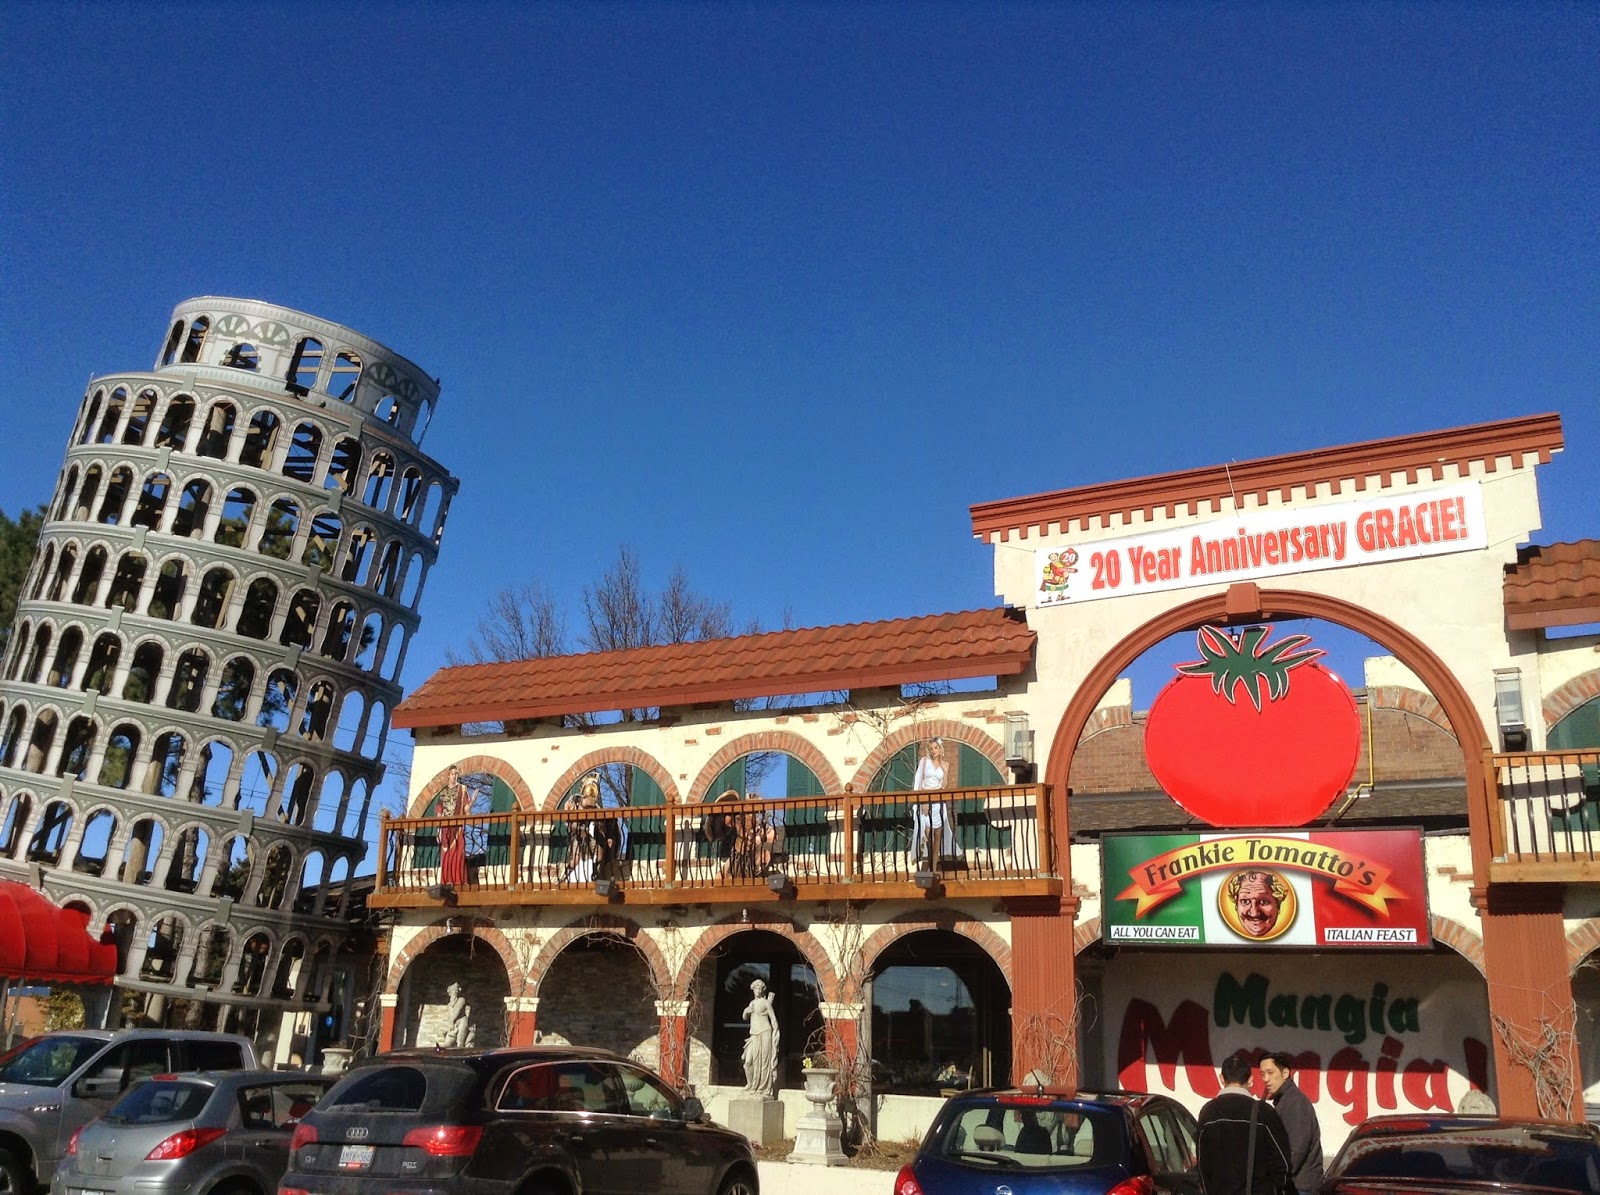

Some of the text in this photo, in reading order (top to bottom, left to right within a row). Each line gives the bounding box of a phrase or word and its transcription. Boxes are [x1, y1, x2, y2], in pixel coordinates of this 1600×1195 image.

[1062, 552, 1076, 563] 20
[1090, 495, 1469, 590] 20 Year Anniversary GRACIE!
[1143, 839, 1377, 887] Frankie Tomatto's
[1113, 927, 1198, 938] ALL YOU CAN EAT
[1327, 929, 1415, 941] ITALIAN FEAST
[1213, 970, 1420, 1046] Mangia
